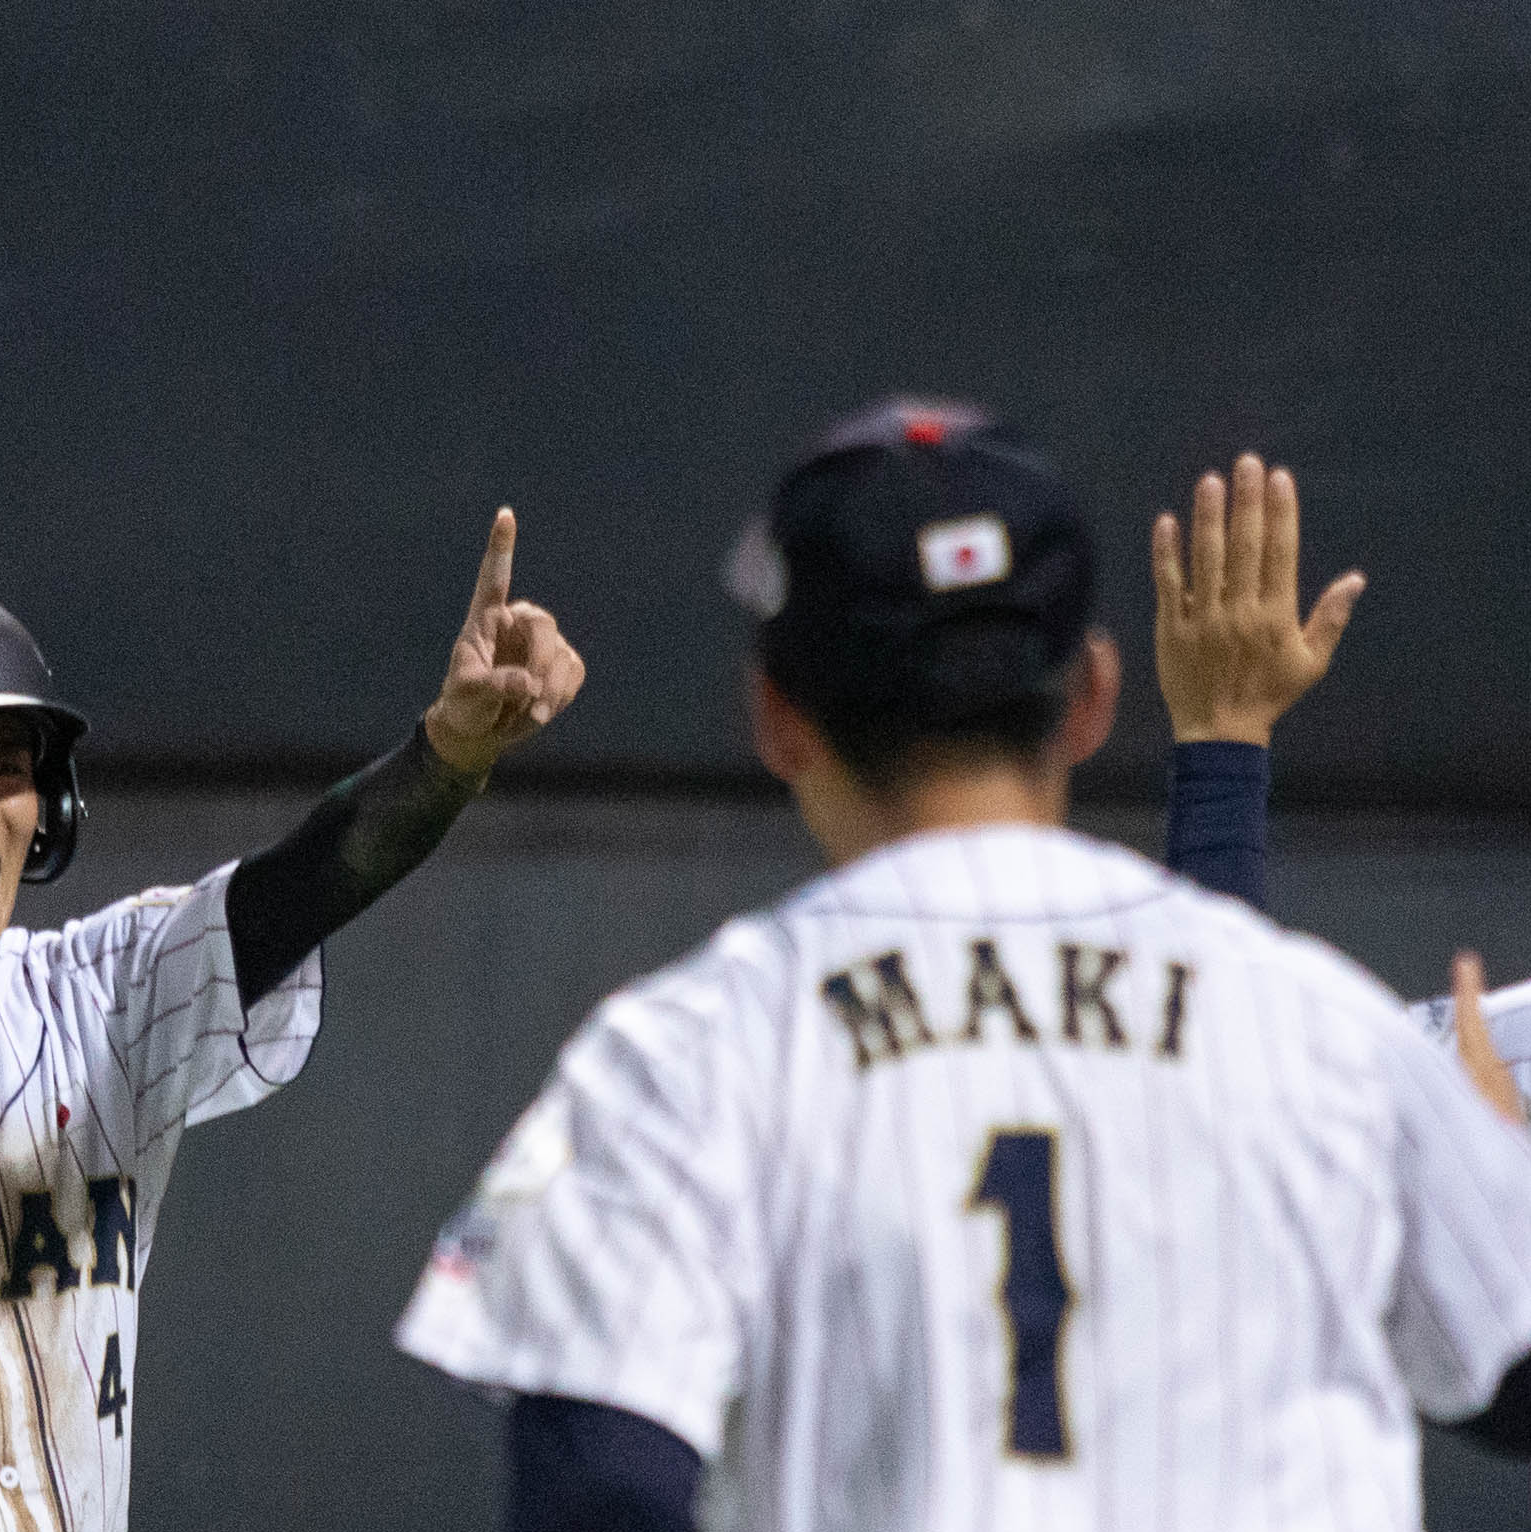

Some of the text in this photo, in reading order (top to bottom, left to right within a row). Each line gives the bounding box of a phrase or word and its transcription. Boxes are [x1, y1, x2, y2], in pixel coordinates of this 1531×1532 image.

[818, 938, 1194, 1073] MAKI
[964, 1124, 1078, 1466] 1
[97, 1331, 127, 1439] 4
